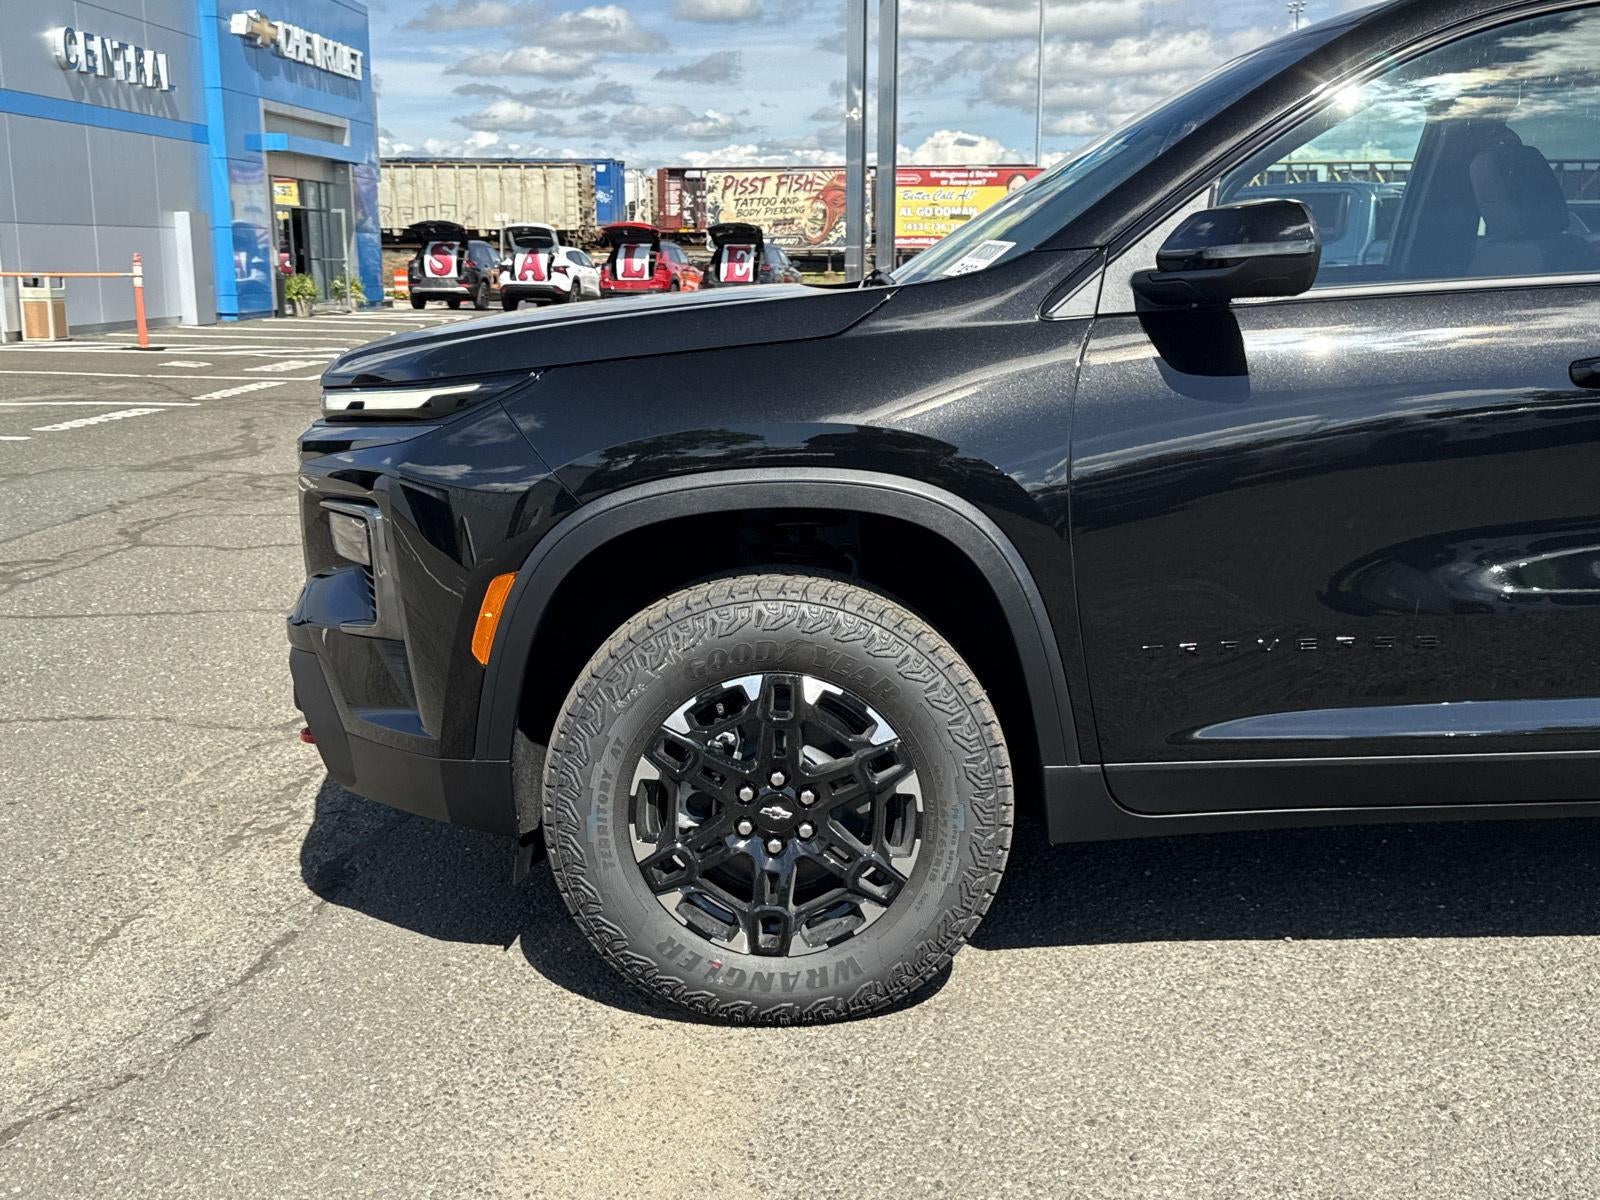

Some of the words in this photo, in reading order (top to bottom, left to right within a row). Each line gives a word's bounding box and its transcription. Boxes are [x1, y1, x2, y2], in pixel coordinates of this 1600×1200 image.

[277, 21, 363, 80] CHEVROLET
[721, 174, 771, 199] PISST
[775, 173, 815, 196] FISH
[932, 189, 955, 201] Call
[733, 197, 777, 210] TATTOO
[780, 196, 800, 206] AND
[736, 207, 762, 218] BODY
[764, 205, 806, 217] PIERCING
[900, 207, 913, 217] AL
[916, 206, 978, 218] GOODMAN
[597, 768, 615, 870] TERRITORY
[655, 936, 865, 993] WRANGLER
